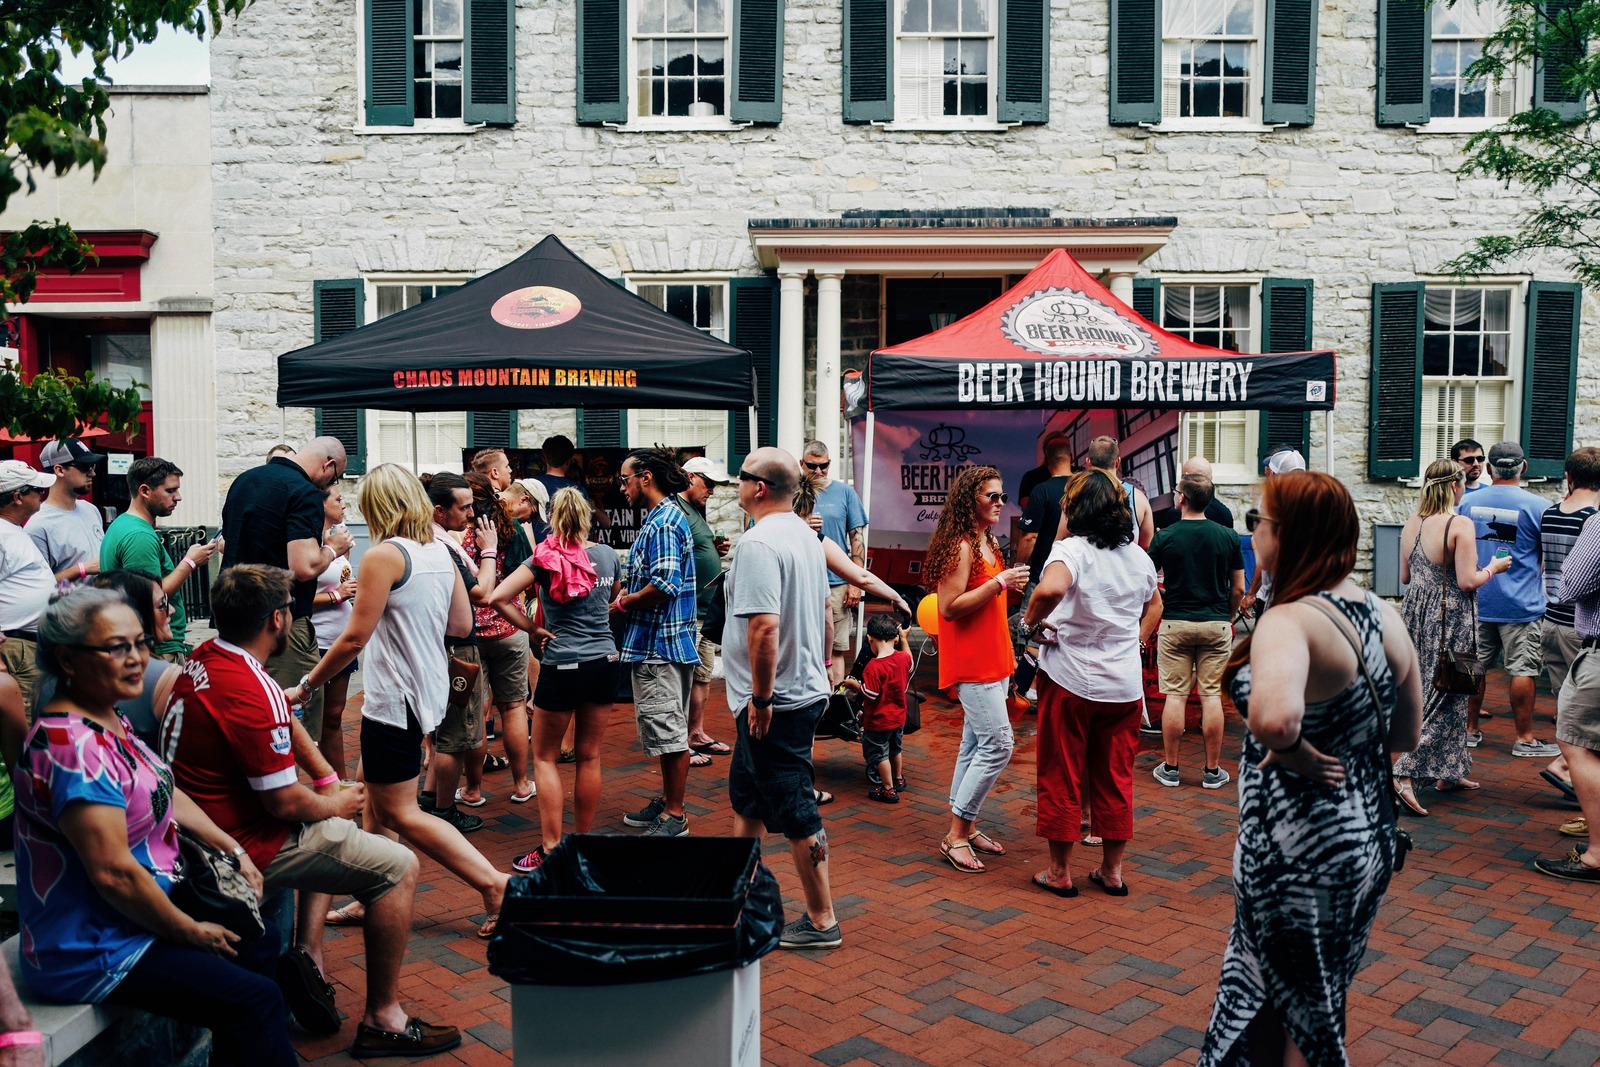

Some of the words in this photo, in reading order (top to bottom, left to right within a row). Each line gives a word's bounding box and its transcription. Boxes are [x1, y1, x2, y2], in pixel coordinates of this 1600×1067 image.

[1025, 324, 1075, 340] BEER
[1076, 326, 1137, 346] HOUND
[393, 369, 453, 389] CHAOS
[458, 367, 550, 387] MOUNTAIN
[555, 368, 637, 388] BREWING
[958, 363, 1025, 402] BEER
[1034, 360, 1121, 402] HOUND
[1131, 360, 1253, 402] BREWERY
[901, 465, 941, 490] BEER
